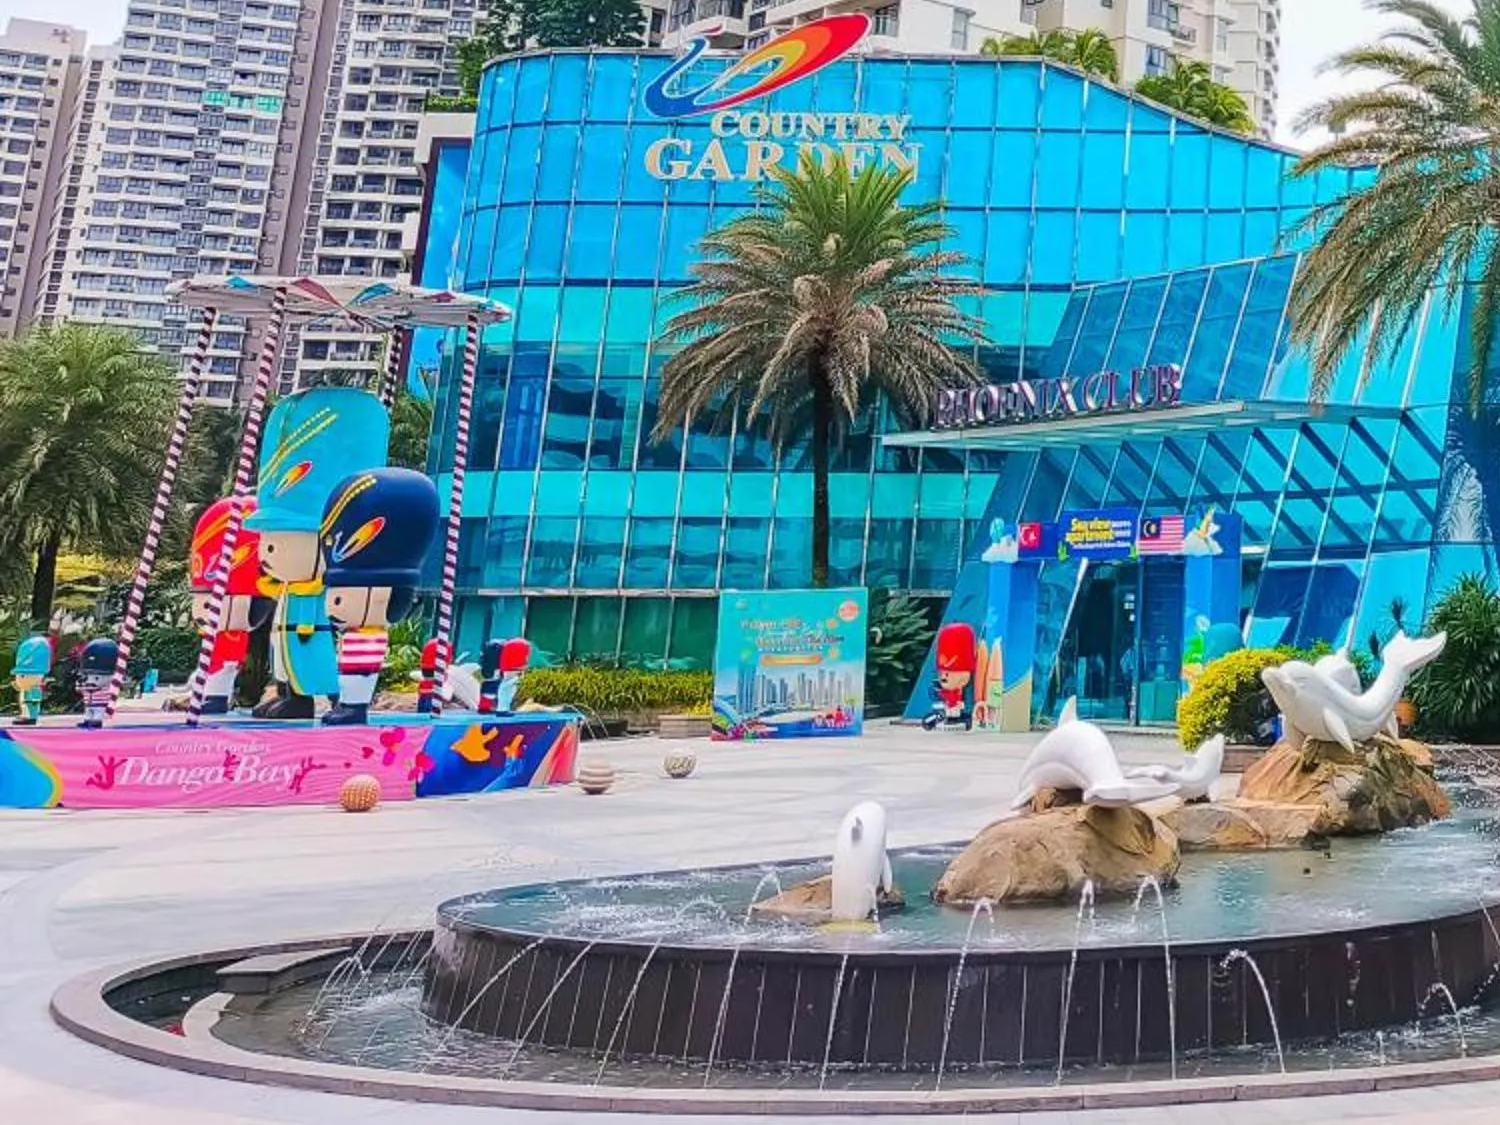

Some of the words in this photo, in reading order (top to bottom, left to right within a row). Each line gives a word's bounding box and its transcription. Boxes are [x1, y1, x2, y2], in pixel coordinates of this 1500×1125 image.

[711, 110, 913, 140] COUNTRY
[932, 376, 1079, 429] PHOENIX
[1082, 363, 1182, 412] CLUB
[118, 755, 225, 793] Danga
[234, 755, 300, 793] Bay
